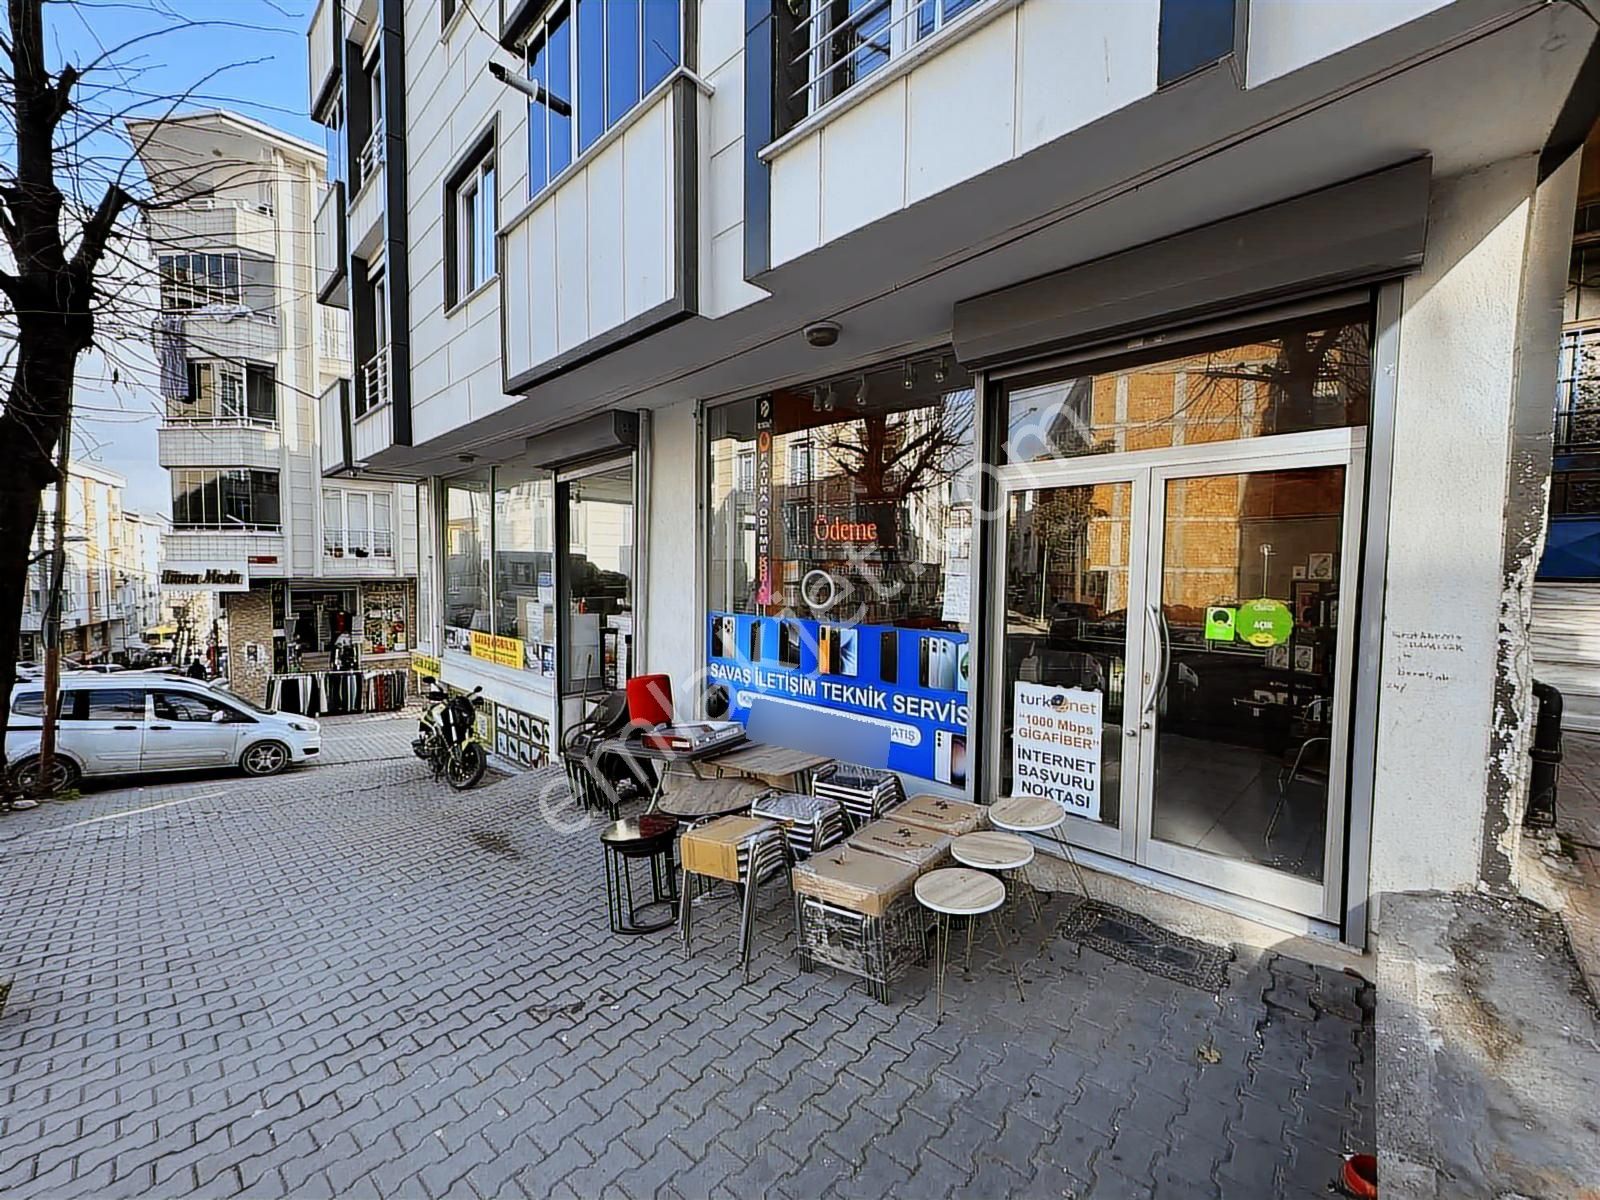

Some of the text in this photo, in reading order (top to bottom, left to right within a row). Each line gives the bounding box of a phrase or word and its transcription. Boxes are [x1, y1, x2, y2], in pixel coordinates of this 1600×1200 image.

[815, 514, 878, 542] Ödeme
[710, 662, 969, 727] SAVAŞ İLETİŞİM TEKNİK SERVİS
[1057, 719, 1094, 736] Mbps
[1017, 744, 1097, 774] İNTERNET
[1018, 764, 1095, 792] BAŞVURU
[1021, 780, 1090, 808] NOKTASI
